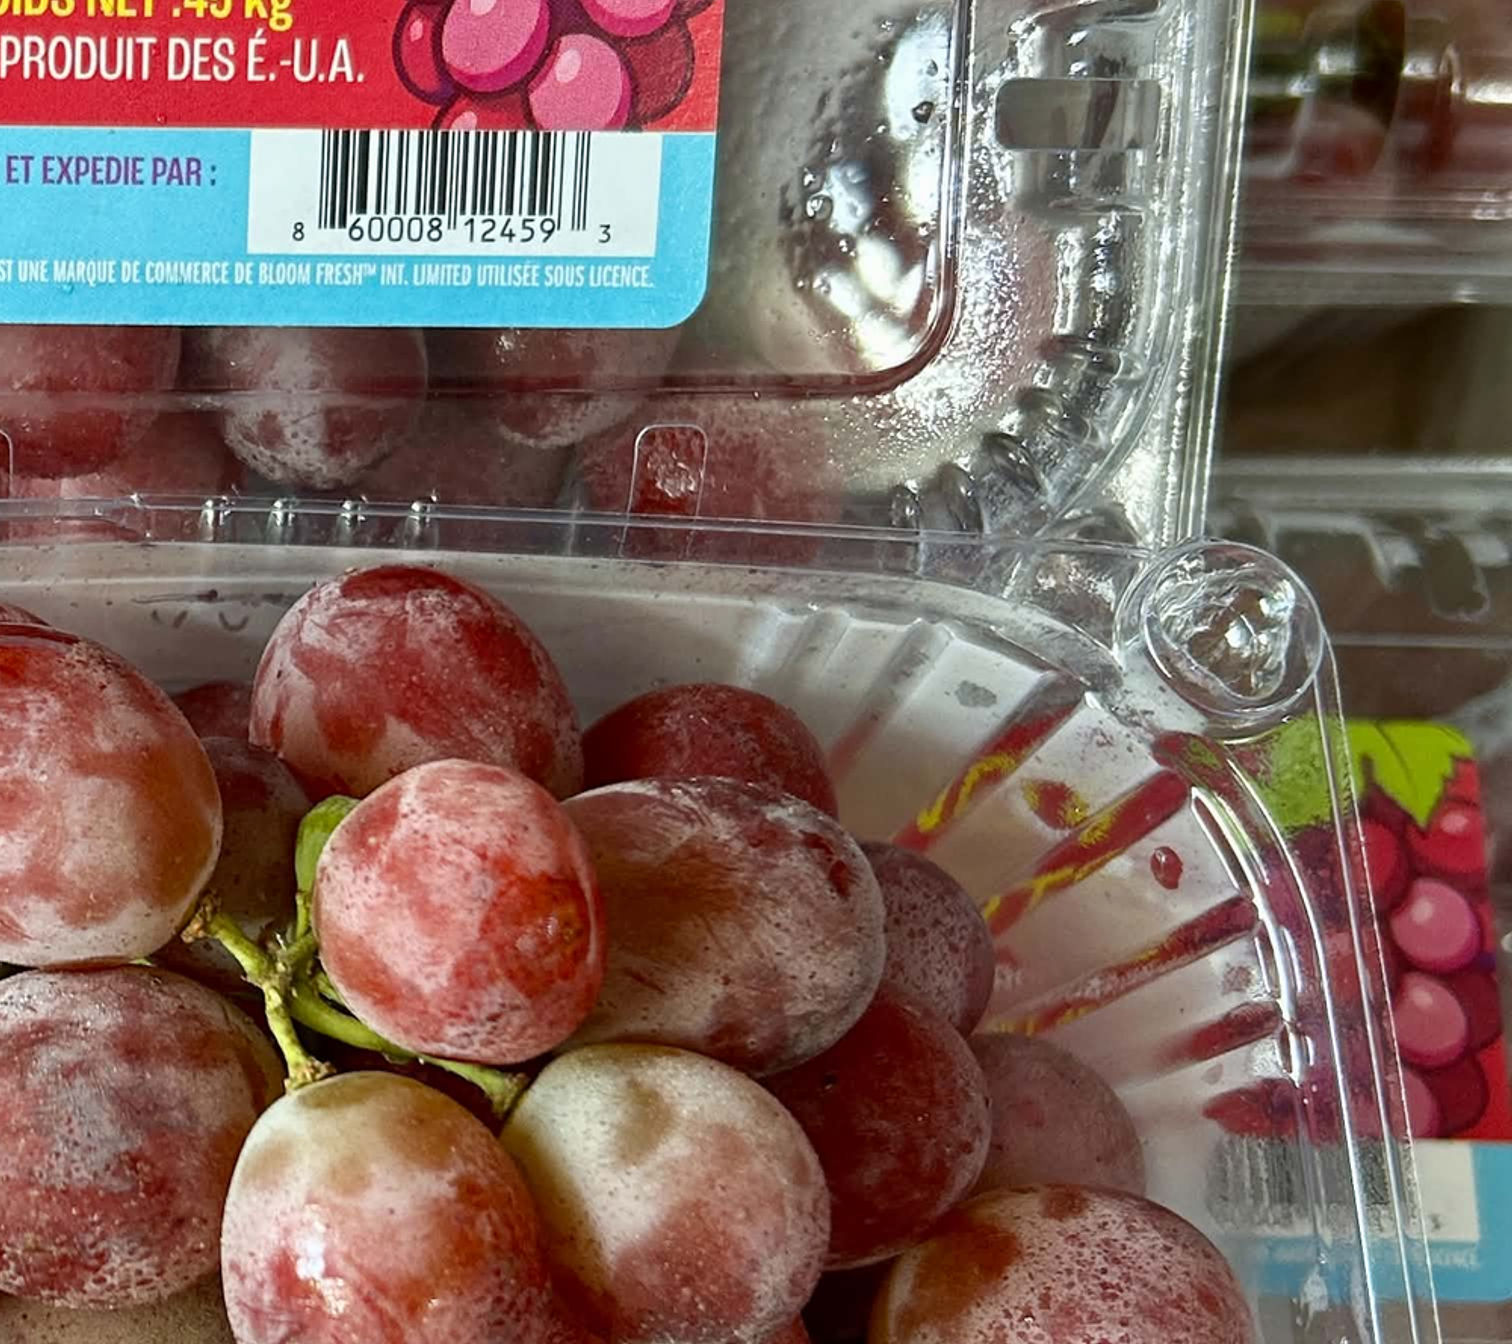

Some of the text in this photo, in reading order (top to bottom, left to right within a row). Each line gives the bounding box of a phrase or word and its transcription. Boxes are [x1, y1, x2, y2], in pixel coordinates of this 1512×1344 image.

[0, 35, 155, 81] PRODUIT
[168, 38, 235, 82] DES
[247, 29, 364, 83] É.-U.A.
[6, 155, 35, 184] ET
[42, 155, 144, 186] EXPEDIE
[151, 157, 202, 186] PAR
[292, 216, 612, 244] 8 60008 12459 3
[18, 261, 48, 284] UNE
[53, 261, 116, 286] MARQUE
[121, 261, 141, 285] DE
[146, 261, 229, 285] COMMERCE
[234, 262, 253, 285] DE
[258, 262, 310, 286] BLOOM
[380, 263, 409, 287] INT.
[413, 263, 471, 287] LIMITED
[476, 259, 539, 287] UTILISÉE
[544, 264, 584, 287] SOUS
[590, 264, 654, 289] LICENCE.
